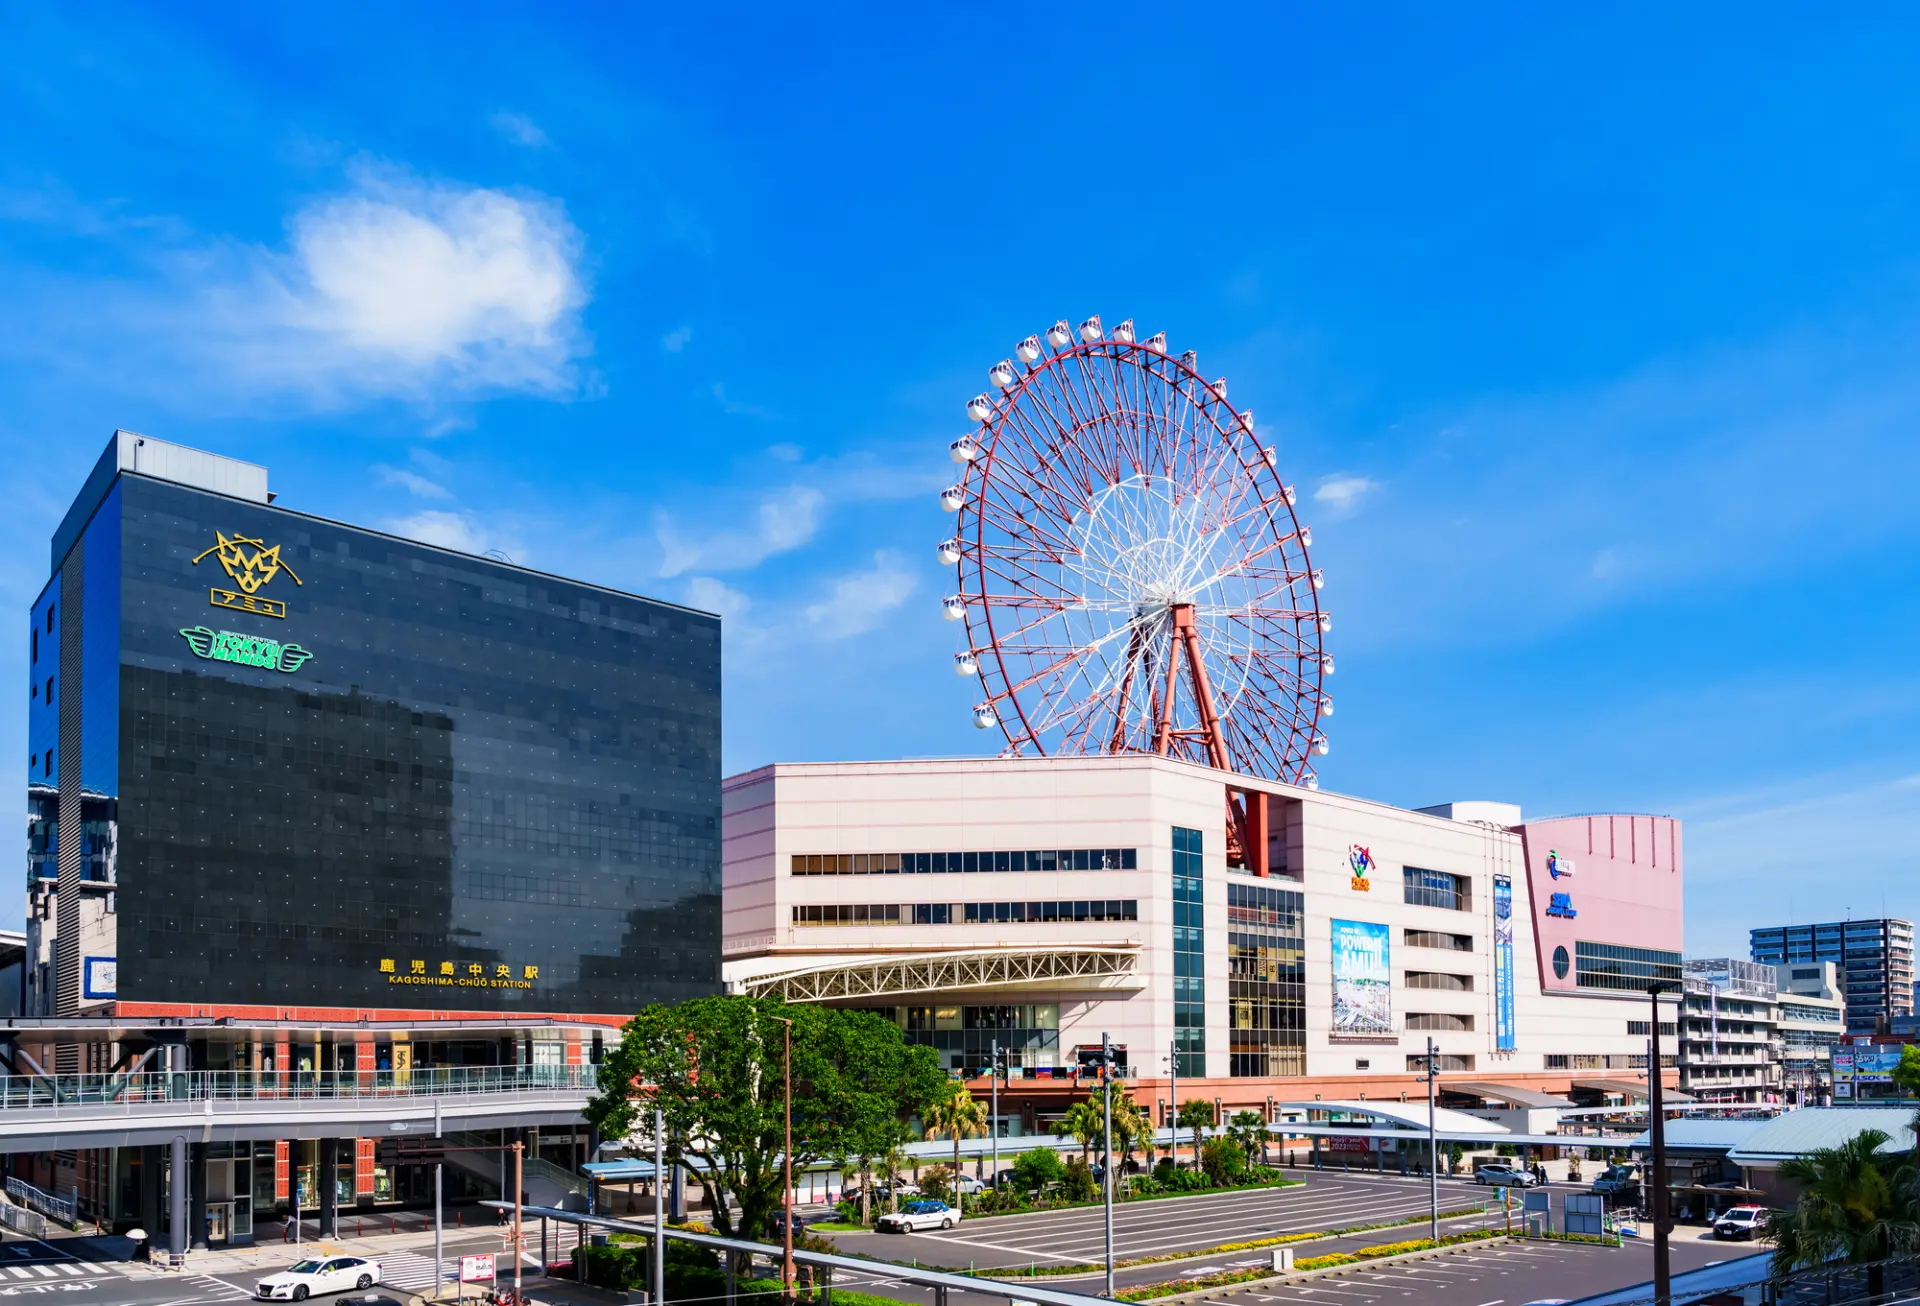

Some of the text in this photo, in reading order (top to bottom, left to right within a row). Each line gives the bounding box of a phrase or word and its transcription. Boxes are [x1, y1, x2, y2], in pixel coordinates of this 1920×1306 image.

[223, 593, 274, 613] アミュ
[217, 634, 281, 657] TOKYU
[214, 646, 276, 670] HANDS
[379, 959, 539, 980] 鹿児島中央駅
[389, 975, 531, 989] KAGOSHIMA-CHŪŌ STATION
